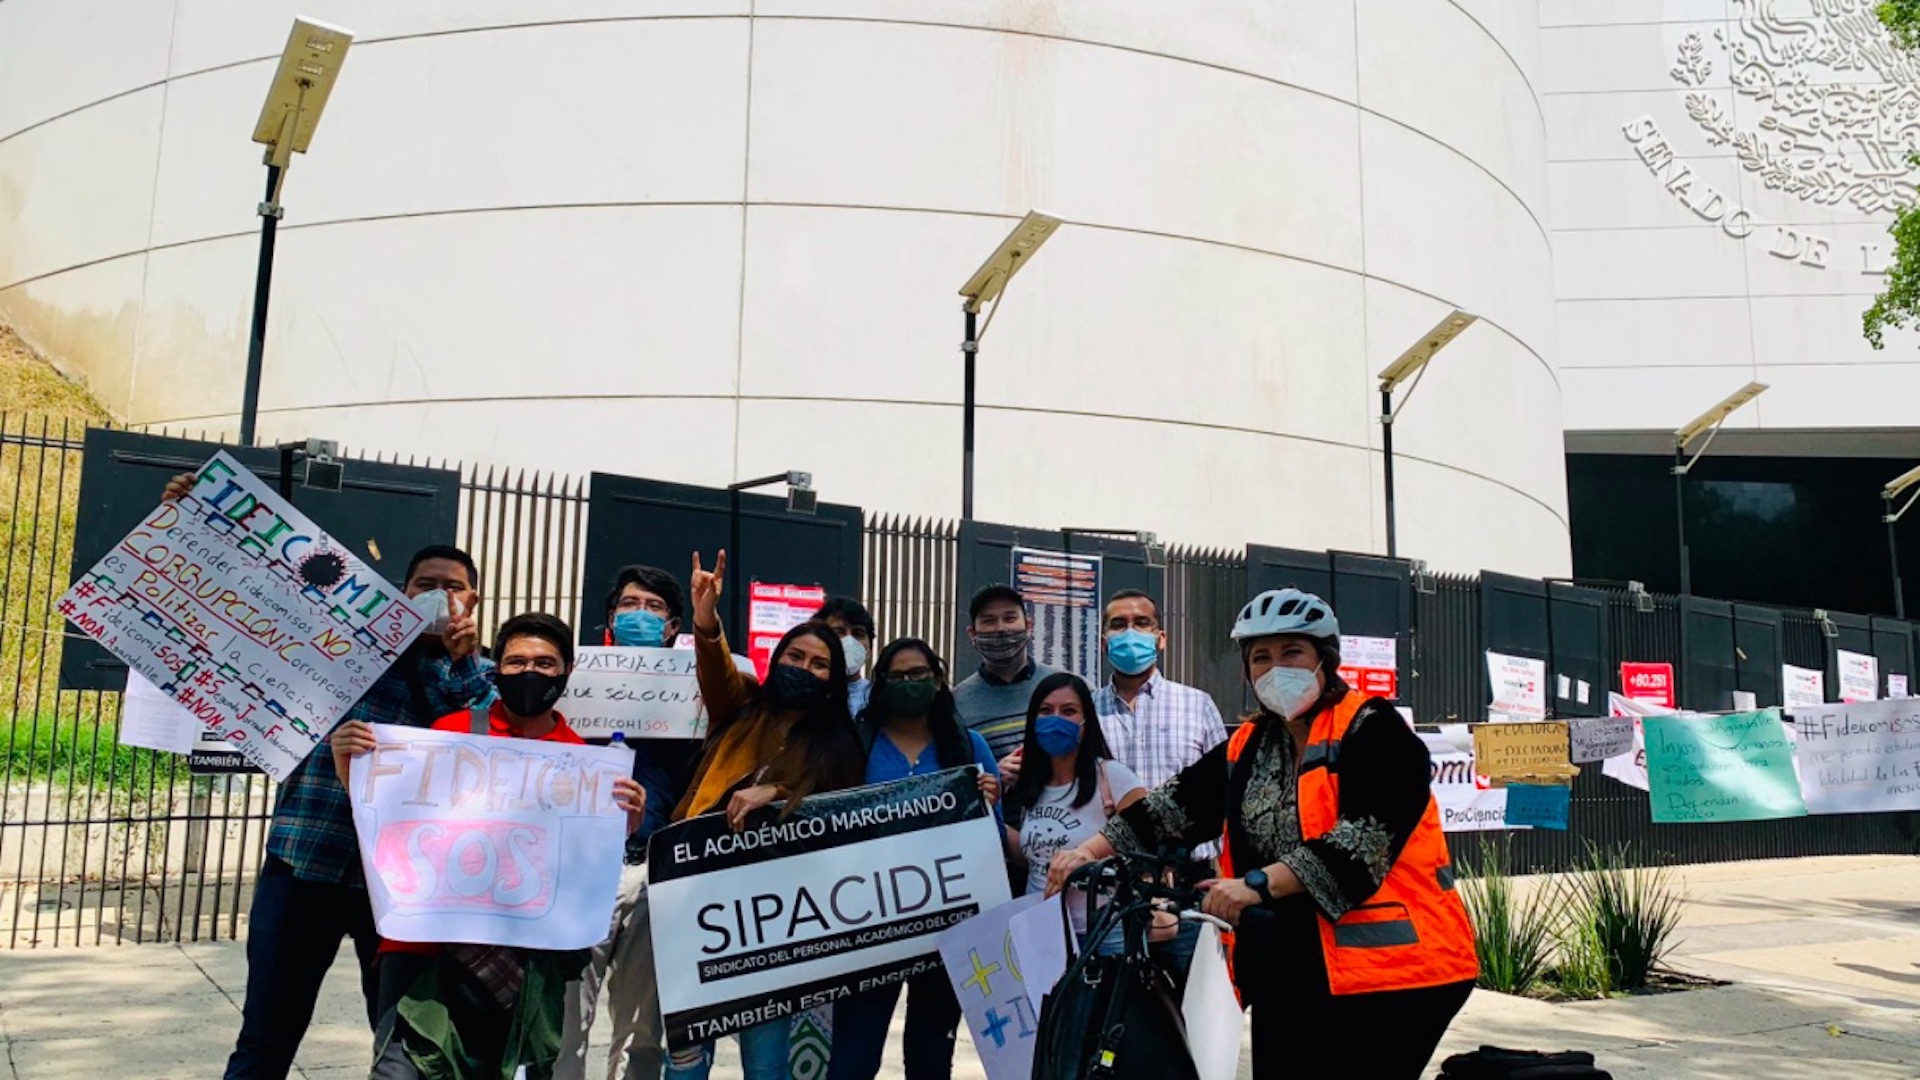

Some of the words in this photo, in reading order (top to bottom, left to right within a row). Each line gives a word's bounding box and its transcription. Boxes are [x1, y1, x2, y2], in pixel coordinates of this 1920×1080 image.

[1622, 115, 1755, 240] SENADO
[1768, 226, 1830, 270] DE
[103, 555, 128, 576] es
[132, 570, 220, 644] Politizar
[221, 633, 242, 664] la
[145, 503, 236, 575] Defender
[313, 627, 352, 657] NO
[344, 657, 365, 676] es
[573, 653, 650, 671] PATRIA
[654, 658, 677, 673] ES
[673, 841, 699, 864] EL
[703, 817, 826, 858] ACADÉMICO
[831, 791, 957, 832] MARCHANDO
[1027, 806, 1082, 831] SHOULD
[382, 823, 544, 908] SOS
[696, 854, 972, 955] SIPACIDE
[703, 955, 767, 978] SINDICATO
[769, 949, 793, 965] DEL
[793, 936, 853, 959] PERSONAL
[855, 920, 925, 949] ACADÉMICO
[925, 915, 948, 930] DEL
[687, 1000, 792, 1041] ¡TAMBIÉN
[799, 985, 851, 1012] ESTA
[858, 959, 944, 992] ENSEÑA
